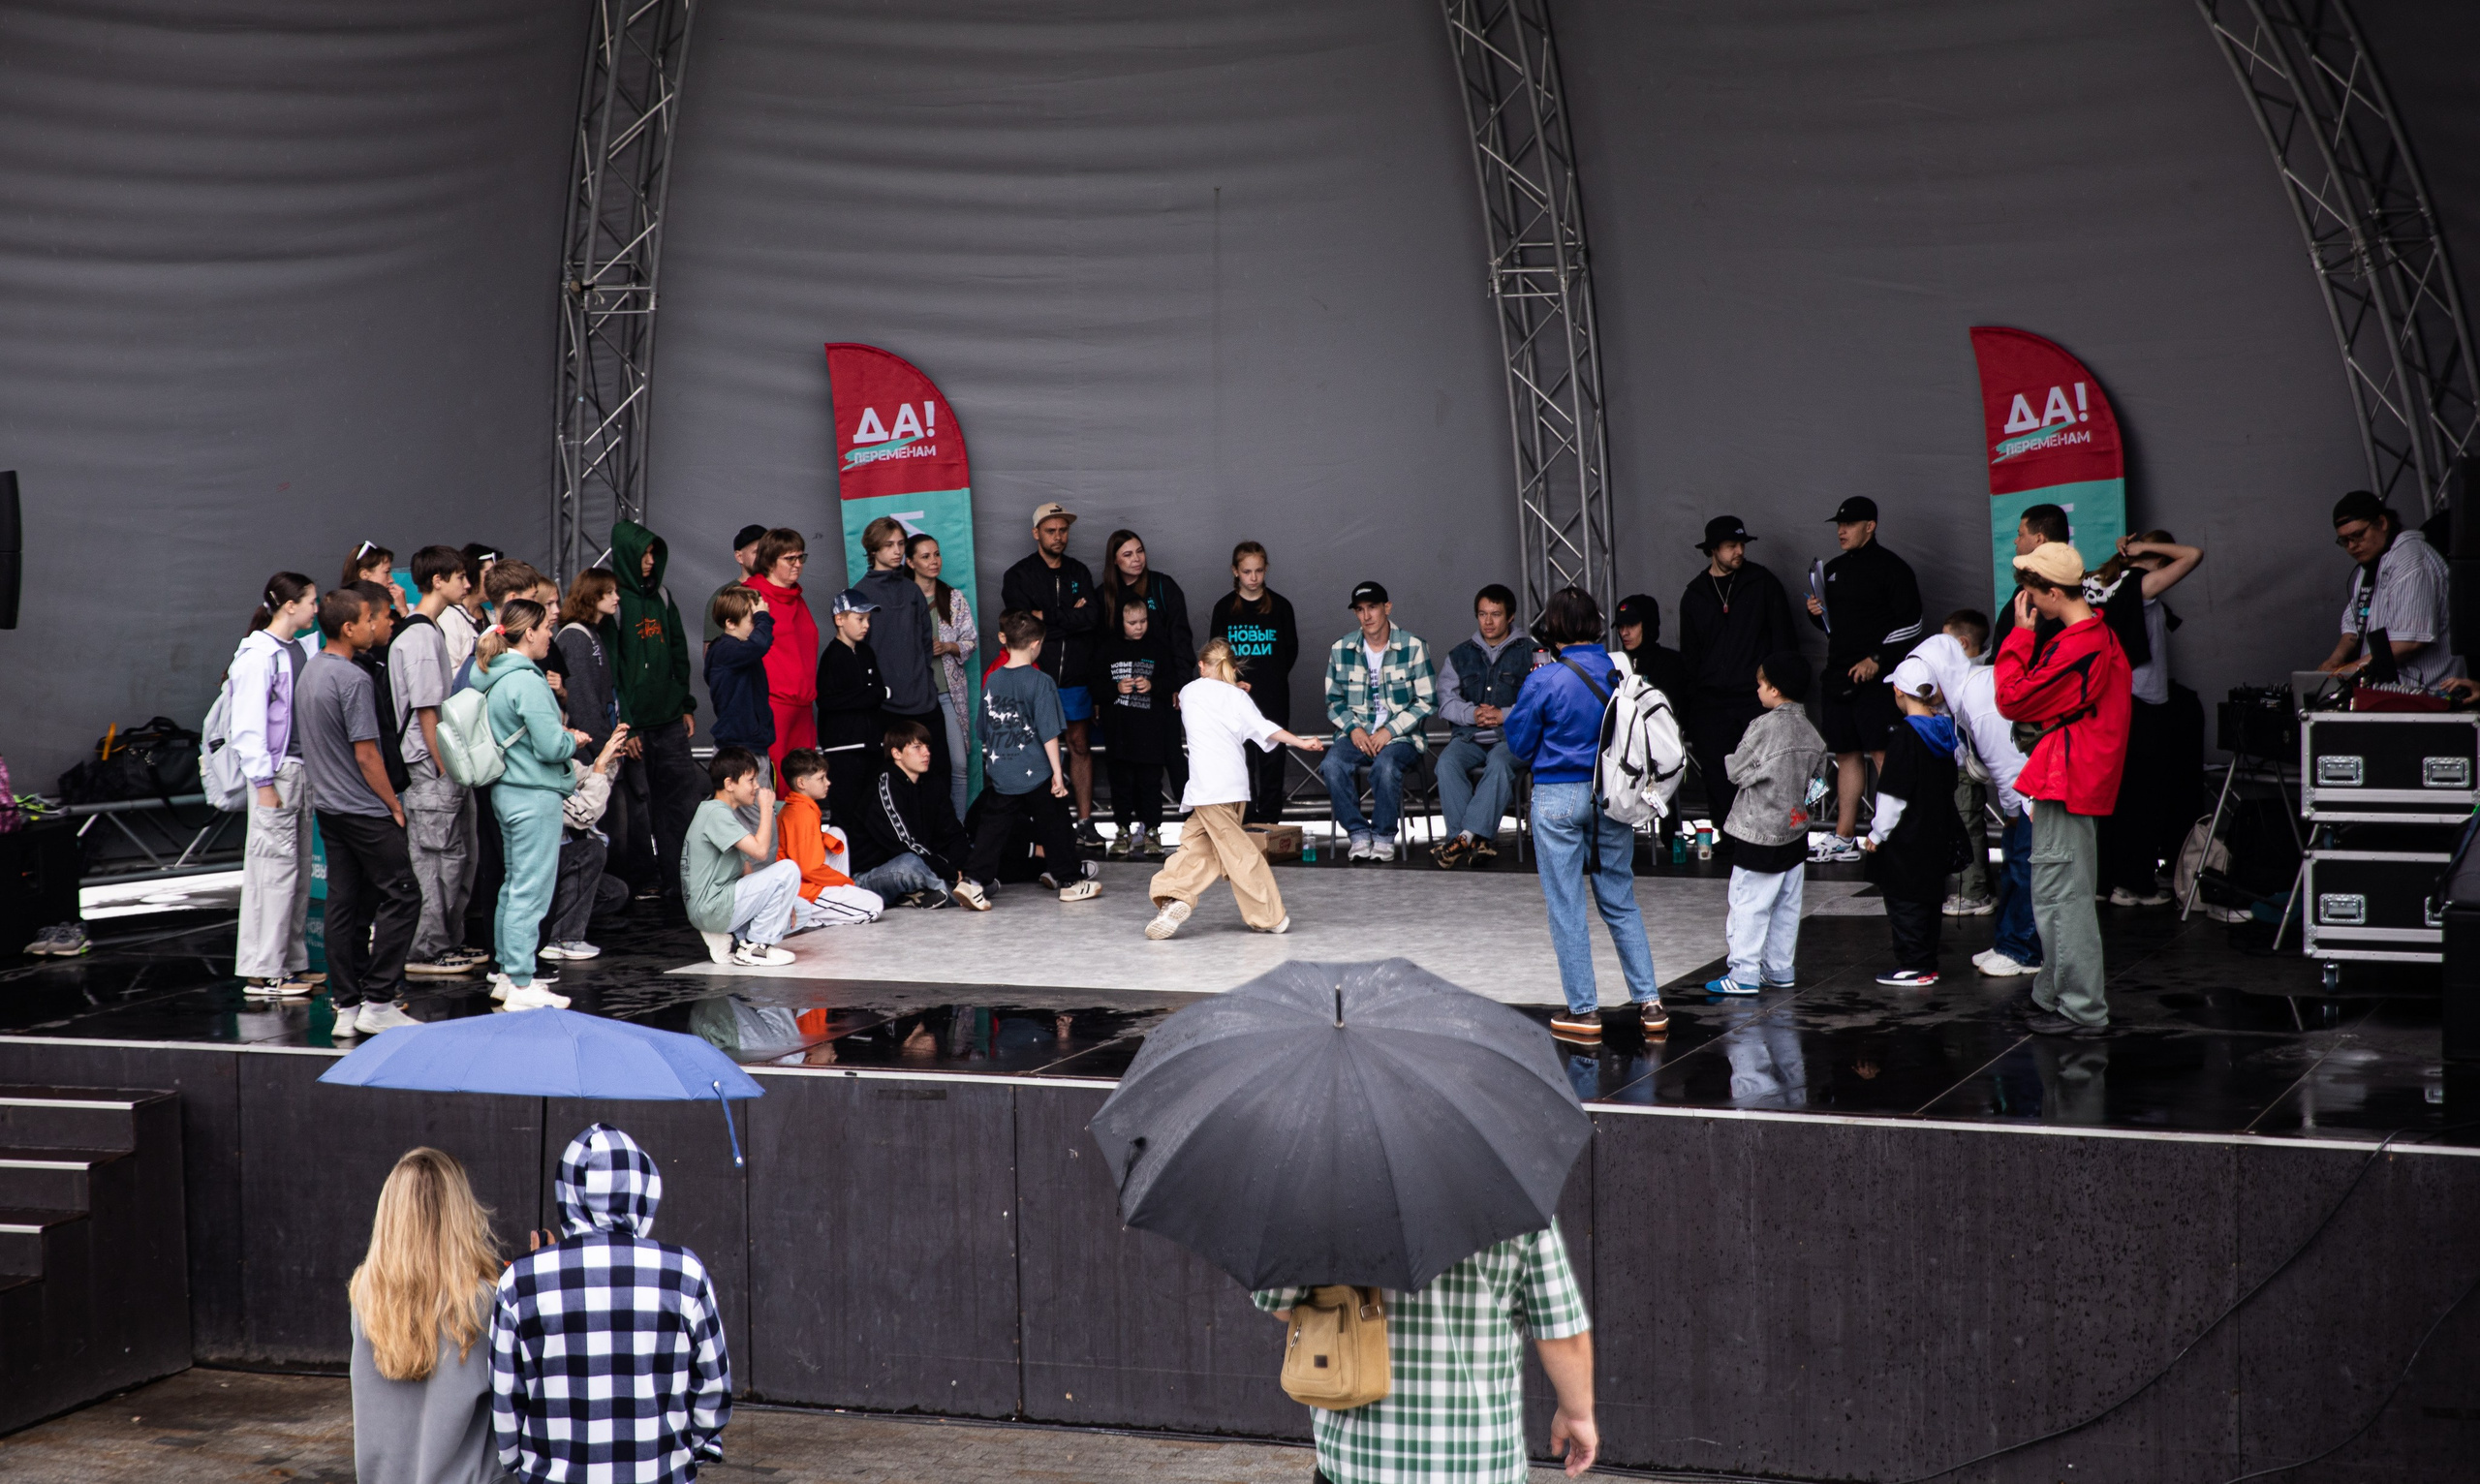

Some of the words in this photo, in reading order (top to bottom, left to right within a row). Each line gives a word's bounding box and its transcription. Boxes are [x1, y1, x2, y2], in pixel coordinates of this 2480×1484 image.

[2003, 383, 2089, 435] ДА!
[852, 400, 936, 445] ДА!
[853, 445, 937, 464] ПЕРЕМЕНАМ
[2005, 430, 2091, 456] ПЕРЕМЕНАМ
[1227, 629, 1277, 642] НОВЫЕ
